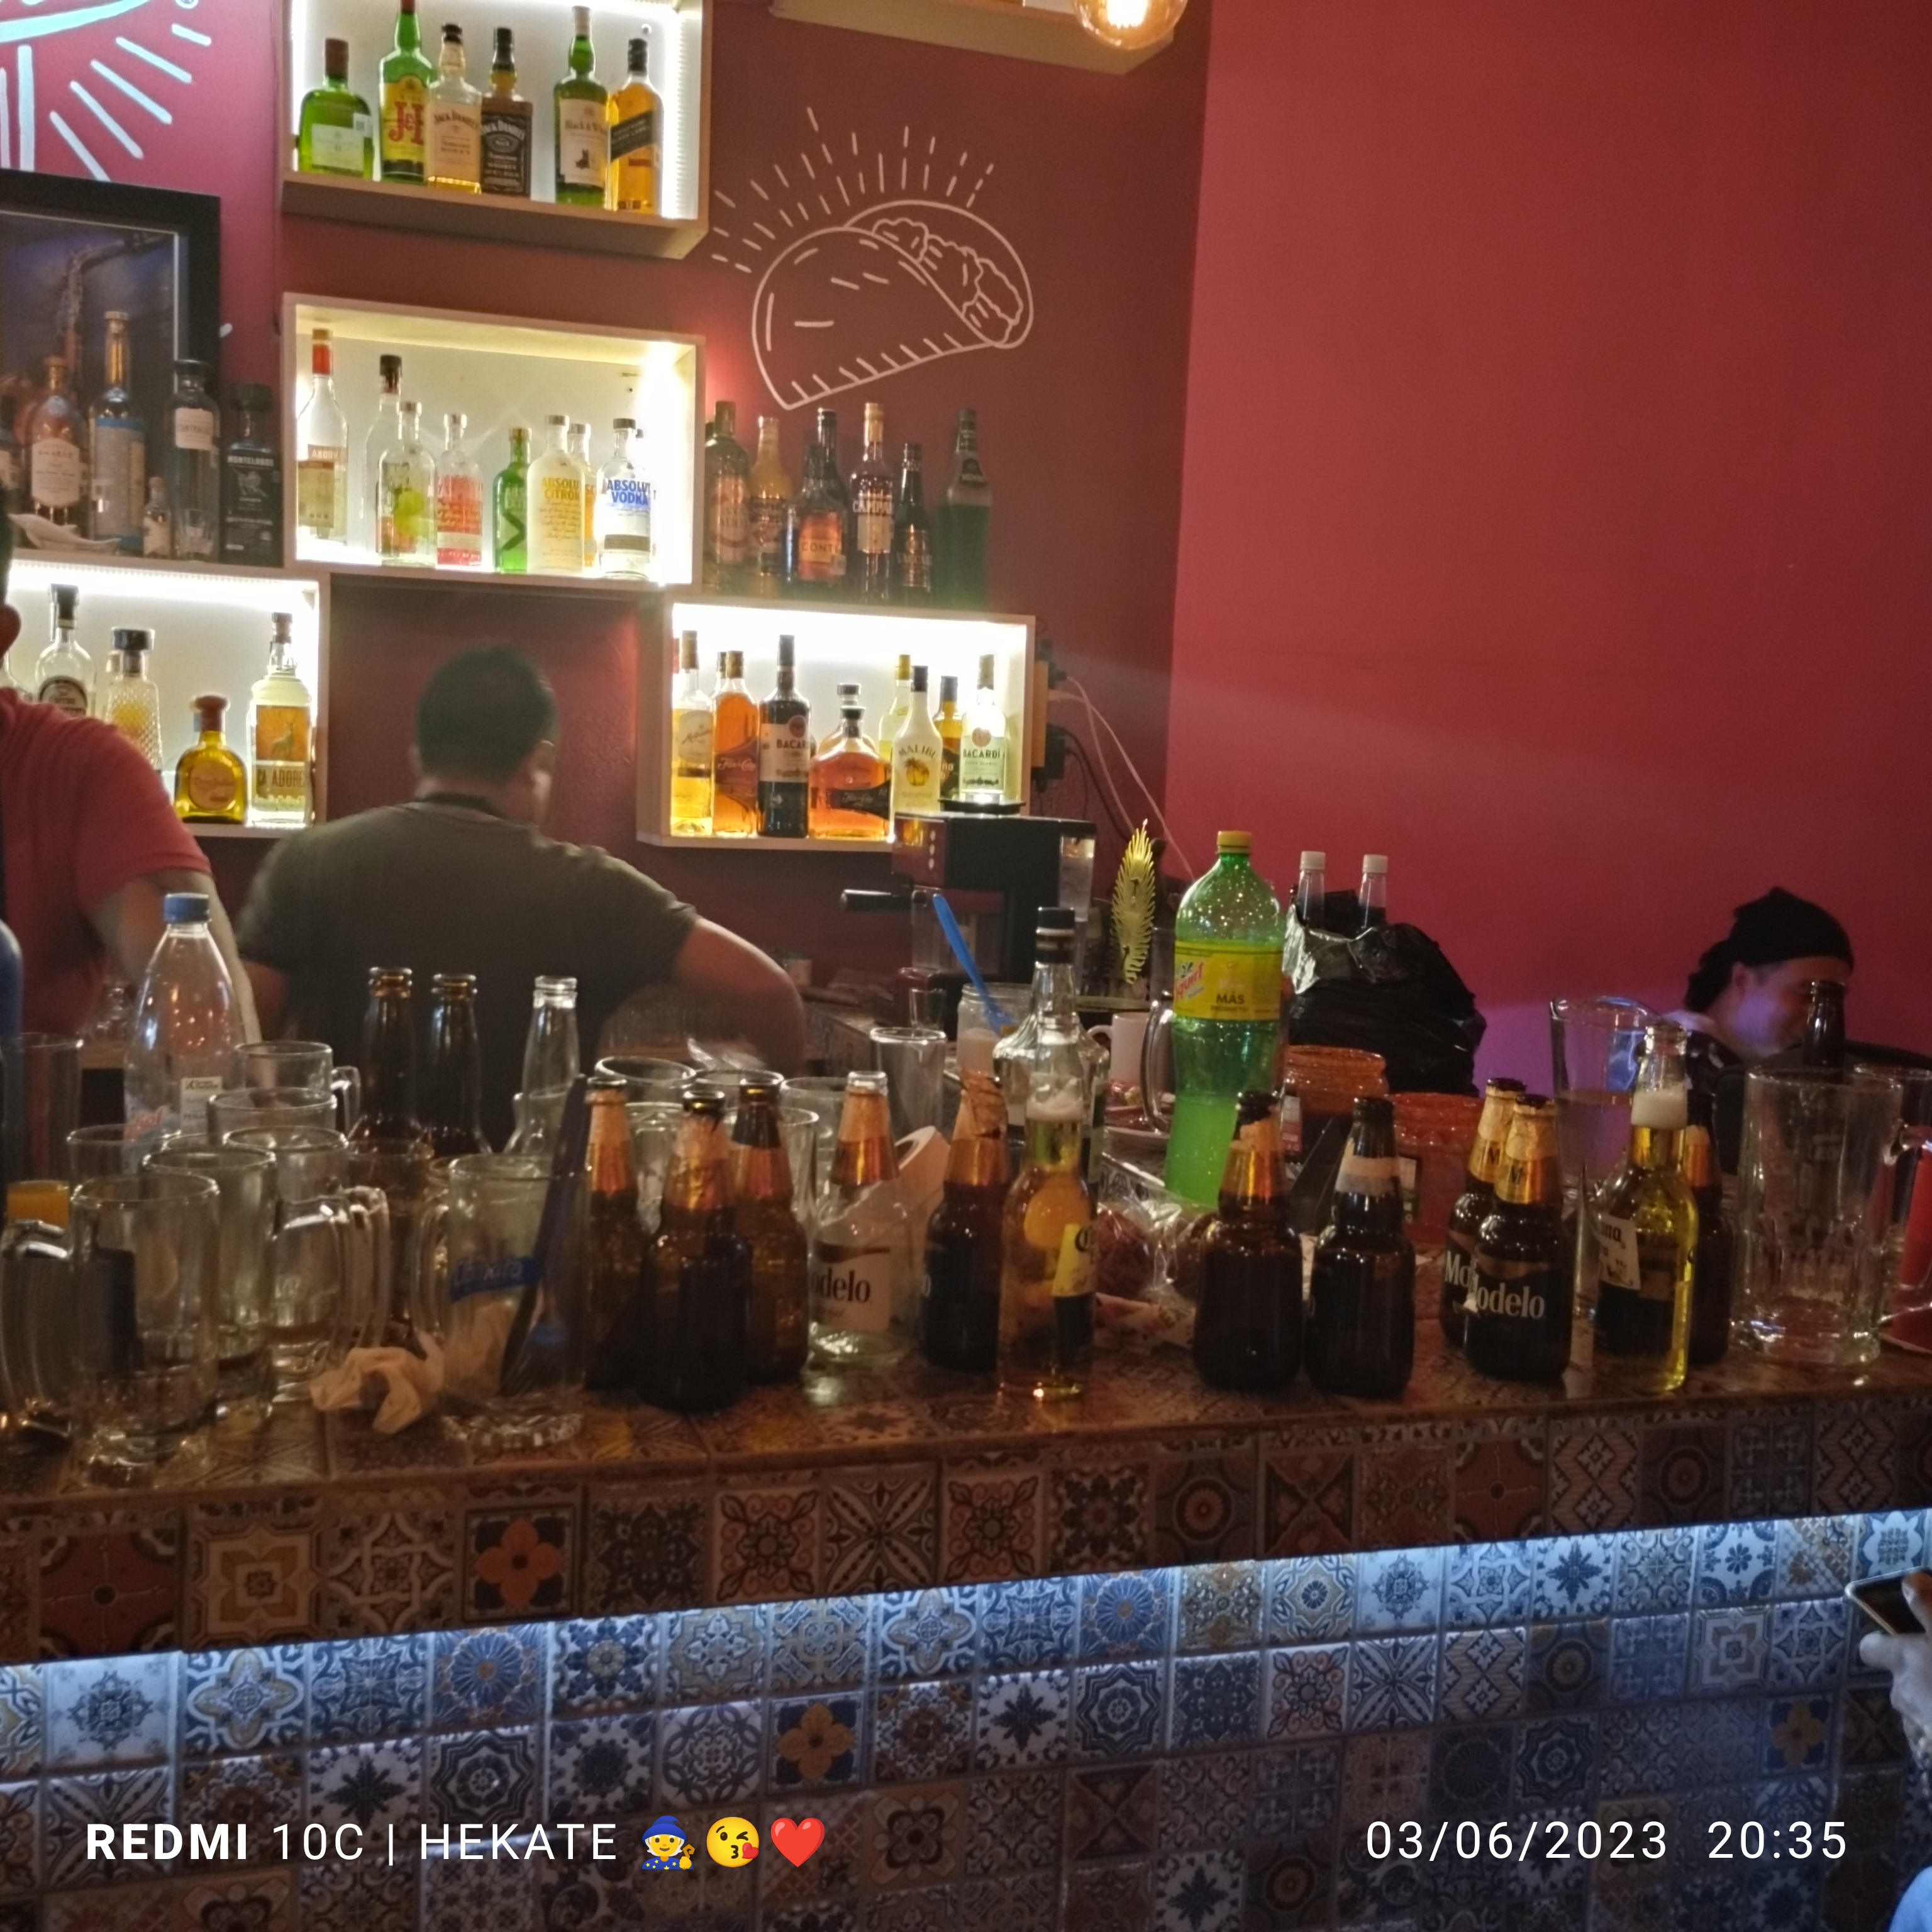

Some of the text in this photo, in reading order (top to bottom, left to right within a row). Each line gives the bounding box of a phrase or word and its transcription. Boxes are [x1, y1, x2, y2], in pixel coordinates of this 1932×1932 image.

[611, 491, 648, 506] VODKA
[775, 738, 813, 749] BACAR
[257, 768, 305, 788] CAADORE
[1175, 961, 1204, 1003] quirt
[1216, 991, 1245, 1005] MÁS
[819, 1267, 872, 1304] delo
